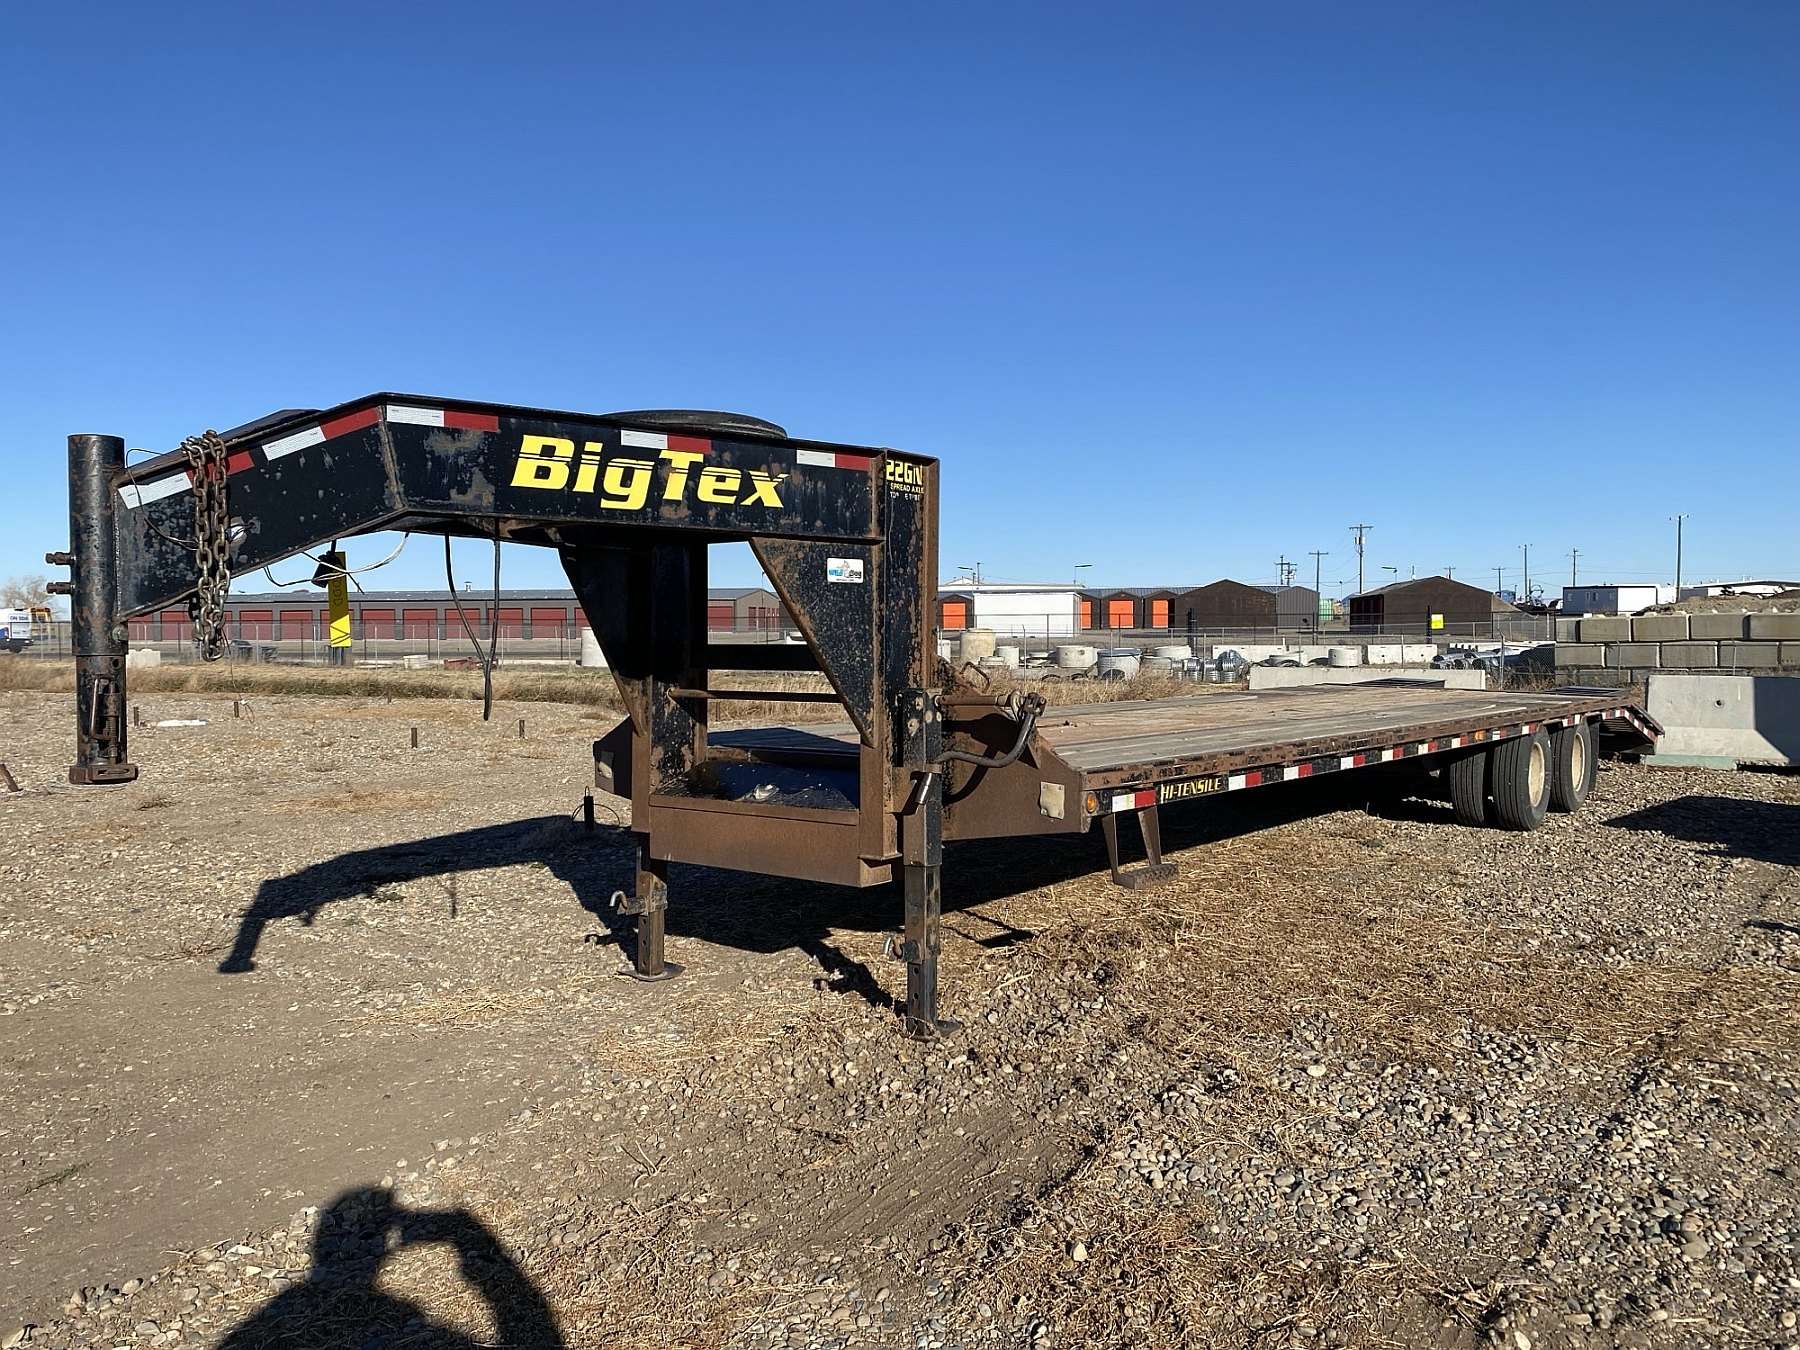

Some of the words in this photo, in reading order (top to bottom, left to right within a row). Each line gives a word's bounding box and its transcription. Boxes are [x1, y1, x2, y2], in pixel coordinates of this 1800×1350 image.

[890, 482, 911, 492] SPREAD
[911, 485, 925, 494] AXLE
[1160, 778, 1222, 800] HI-TENSILE
